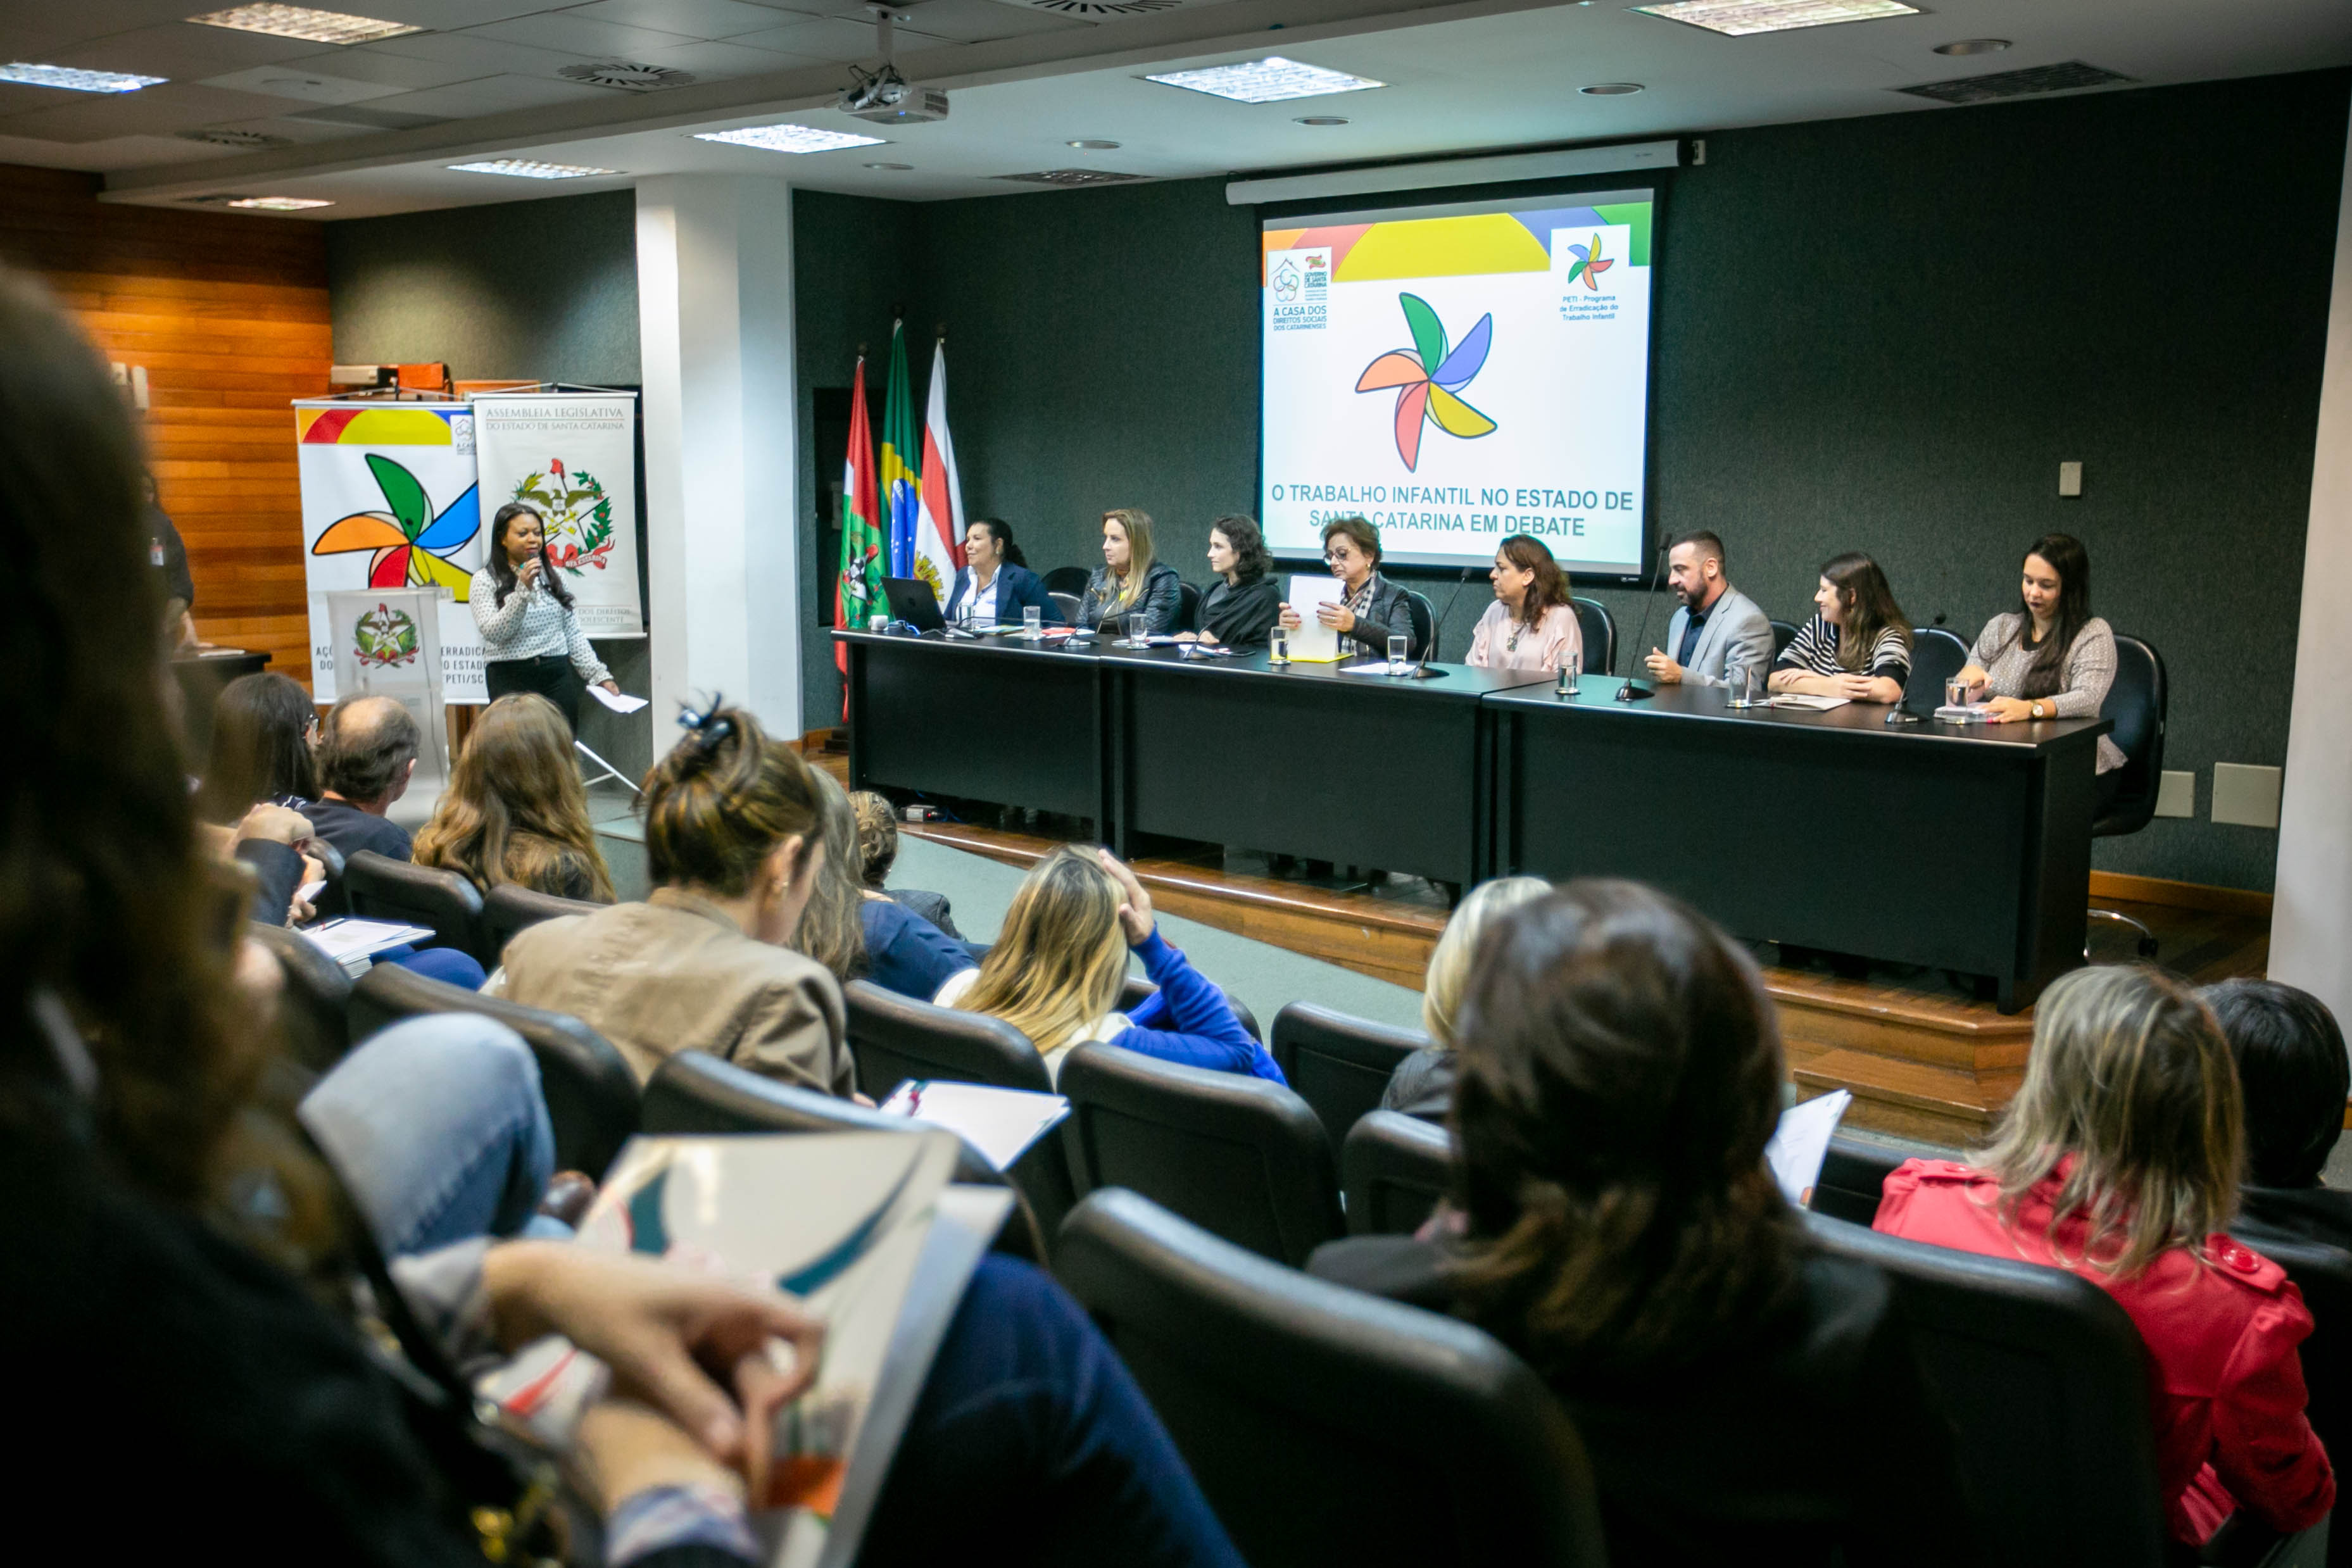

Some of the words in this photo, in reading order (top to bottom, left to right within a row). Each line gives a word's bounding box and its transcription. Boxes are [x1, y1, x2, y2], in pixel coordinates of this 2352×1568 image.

[1583, 295, 1616, 303] Programa
[1273, 307, 1280, 317] A
[1281, 306, 1305, 316] CASA
[1308, 305, 1326, 315] DOS
[486, 408, 551, 418] ASSEMBLEIA
[555, 407, 624, 418] LEGISLATIVA
[486, 422, 500, 430] DO
[502, 422, 535, 430] ESTADO
[538, 422, 548, 430] DE
[551, 422, 579, 430] SANTA
[580, 422, 624, 430] CATARINA
[1272, 484, 1284, 501] O
[1289, 484, 1387, 503] TRABALHO
[1392, 486, 1475, 505] INFANTIL
[1481, 488, 1509, 506] NO
[1516, 489, 1598, 509] ESTADO
[1605, 491, 1633, 510] DE
[1373, 511, 1464, 530] CATARINA
[1471, 514, 1497, 532] EM
[1505, 515, 1585, 536] DEBATE
[446, 674, 484, 684] PETI/SC
